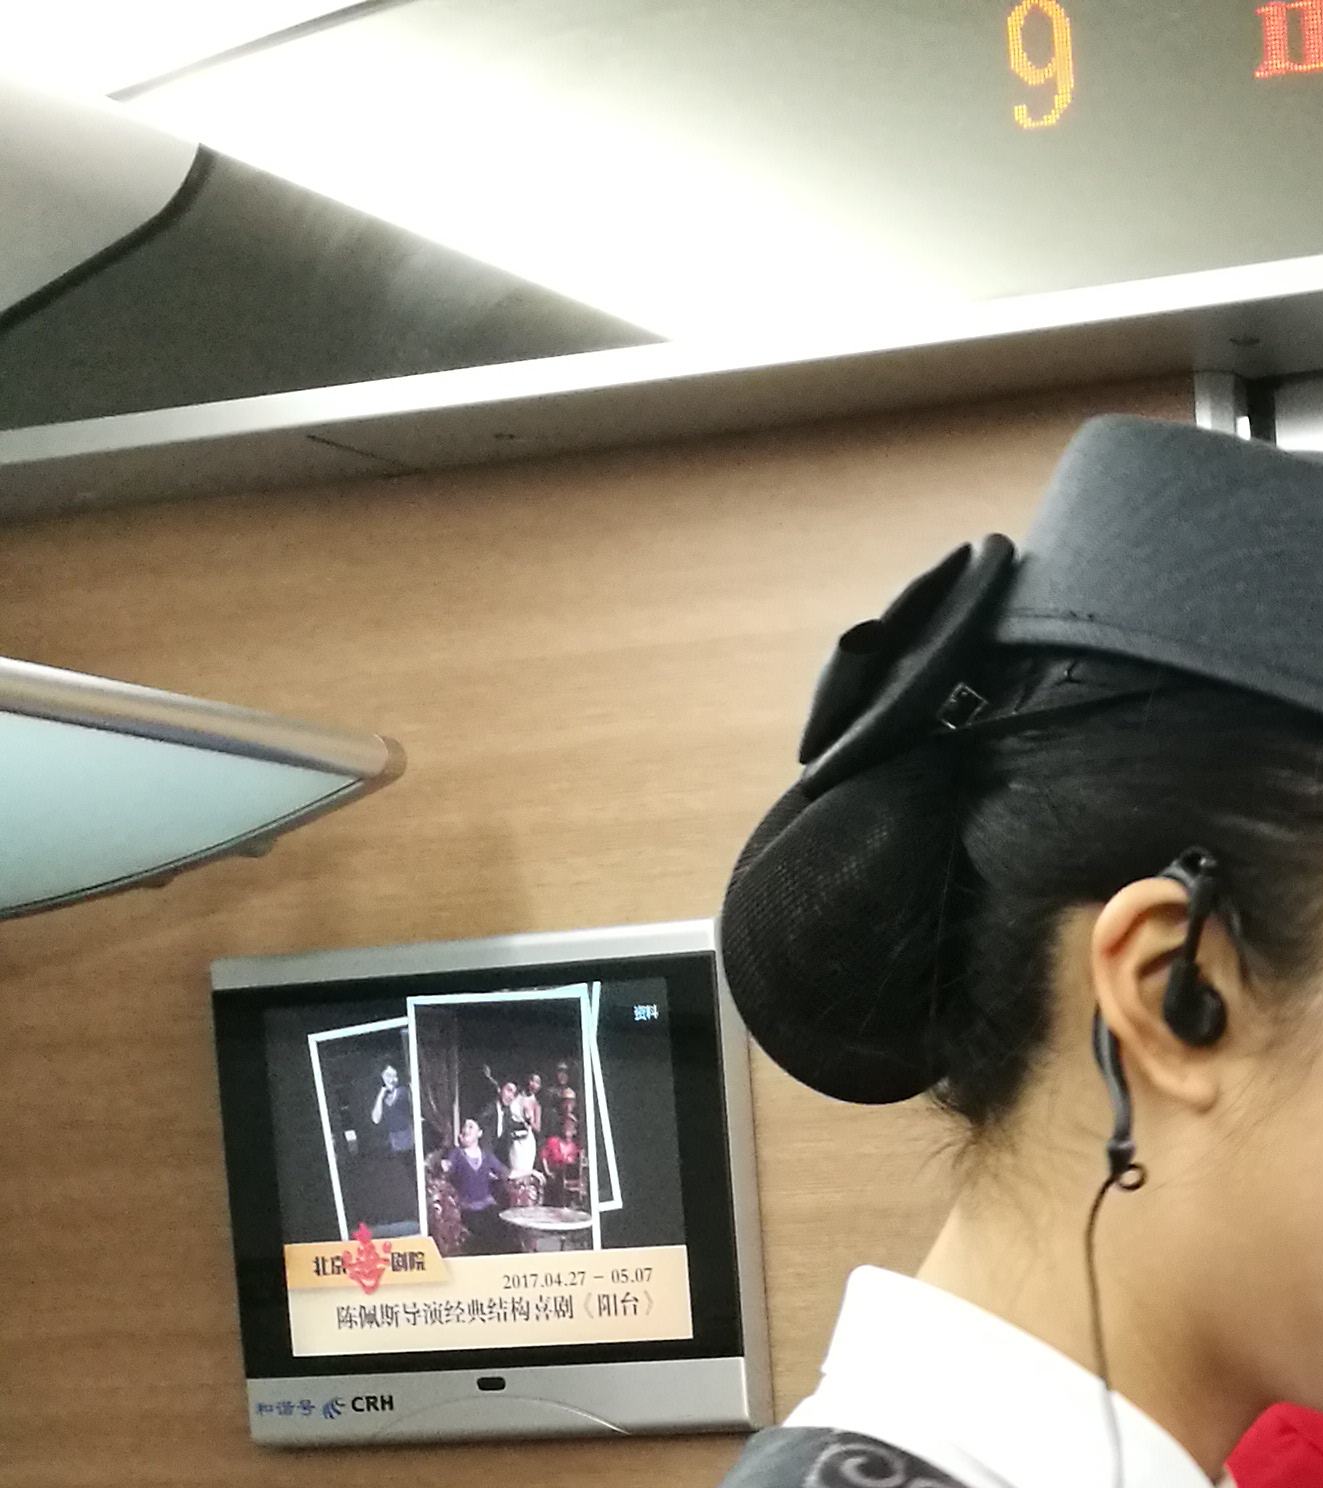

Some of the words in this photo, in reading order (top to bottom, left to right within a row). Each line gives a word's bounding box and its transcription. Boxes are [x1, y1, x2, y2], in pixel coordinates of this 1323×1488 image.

[1007, 0, 1074, 128] 9
[502, 1271, 586, 1290] 2017.04.27
[610, 1267, 653, 1284] 05.07
[351, 1394, 394, 1412] CRH
